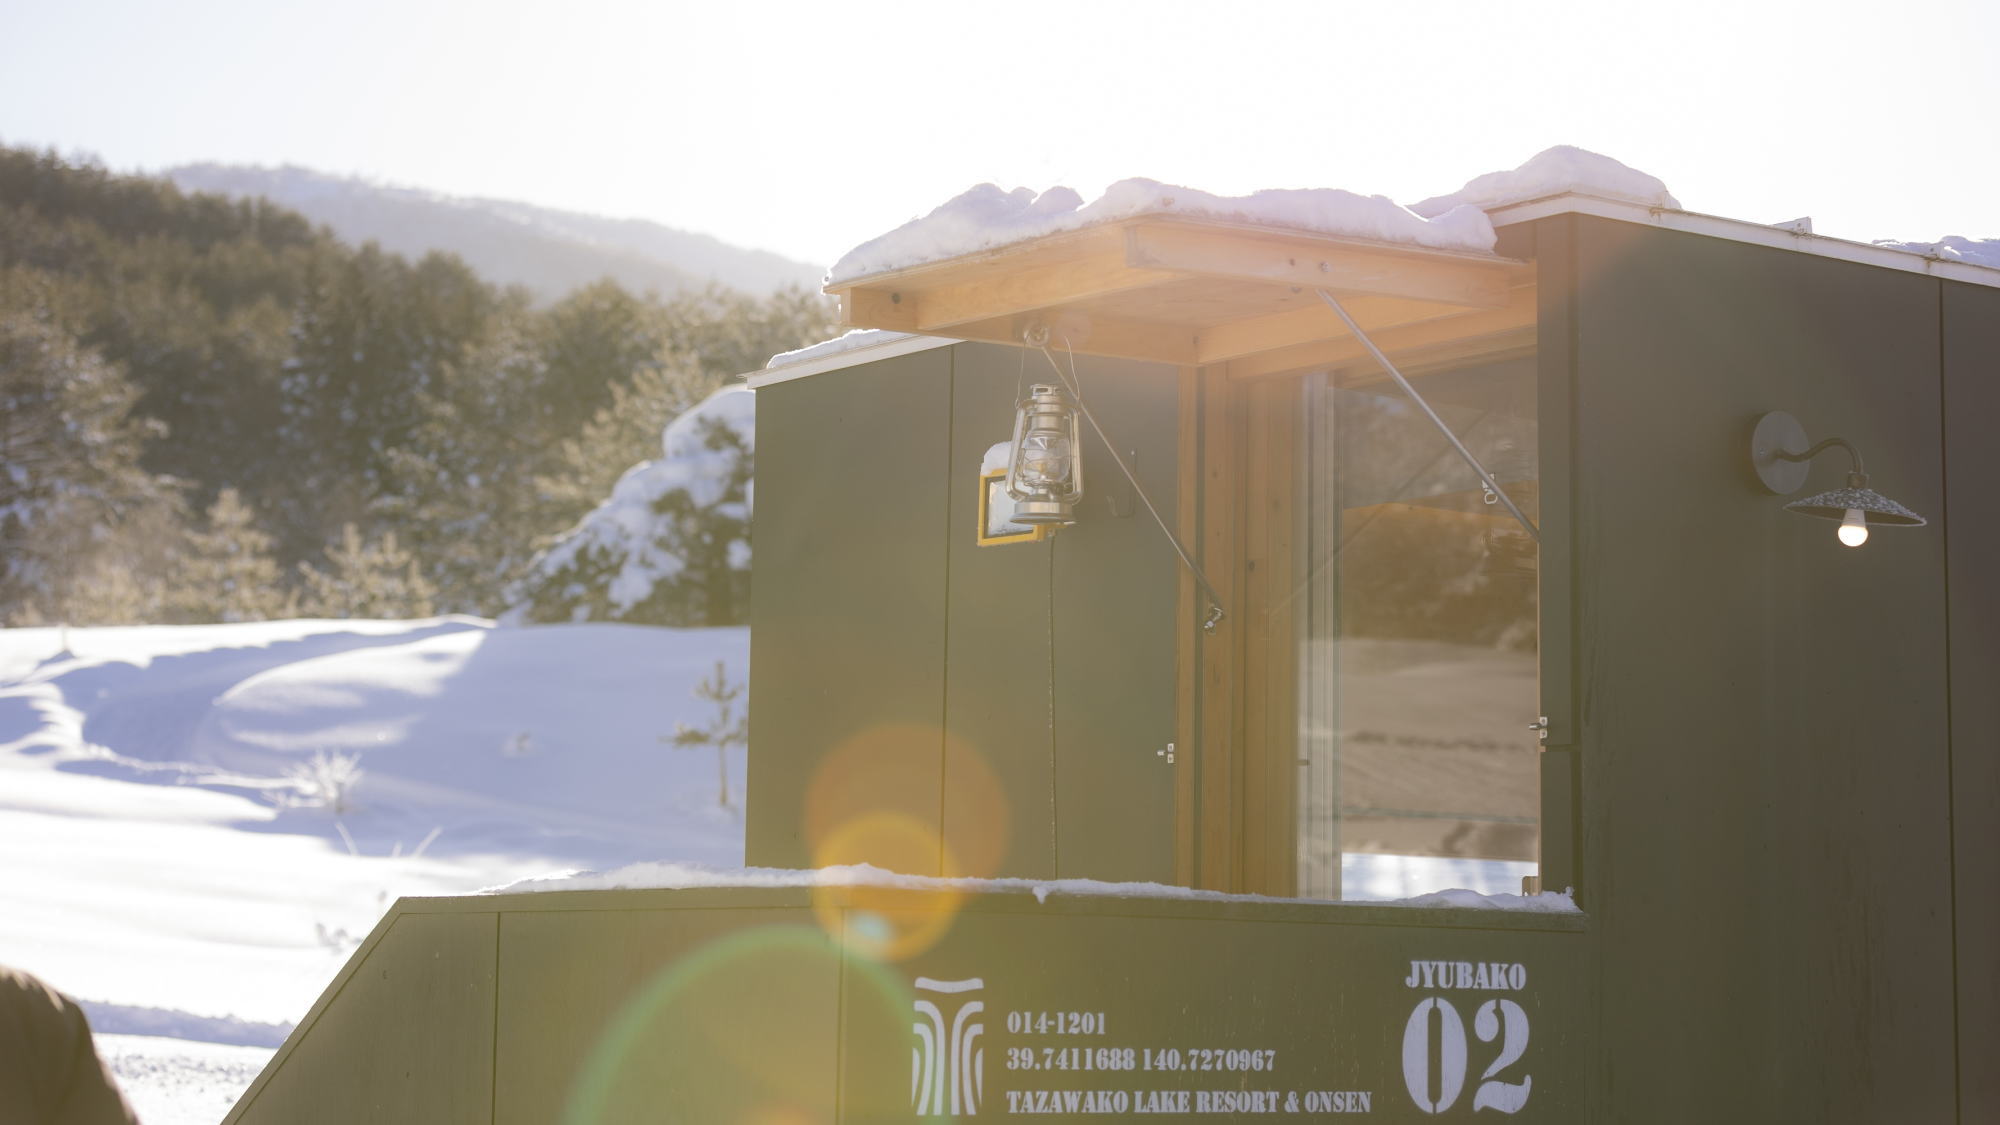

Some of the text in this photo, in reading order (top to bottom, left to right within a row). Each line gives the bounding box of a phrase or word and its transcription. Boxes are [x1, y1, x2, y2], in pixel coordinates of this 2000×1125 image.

[1405, 960, 1526, 990] JYUBAKO
[1007, 1011, 1105, 1034] 014-1201
[1006, 1047, 1275, 1071] 39.7411688 140.7270967
[1402, 997, 1531, 1113] 02
[1006, 1090, 1372, 1113] TAZAWAKO LAKE RESORT & ONSEN
